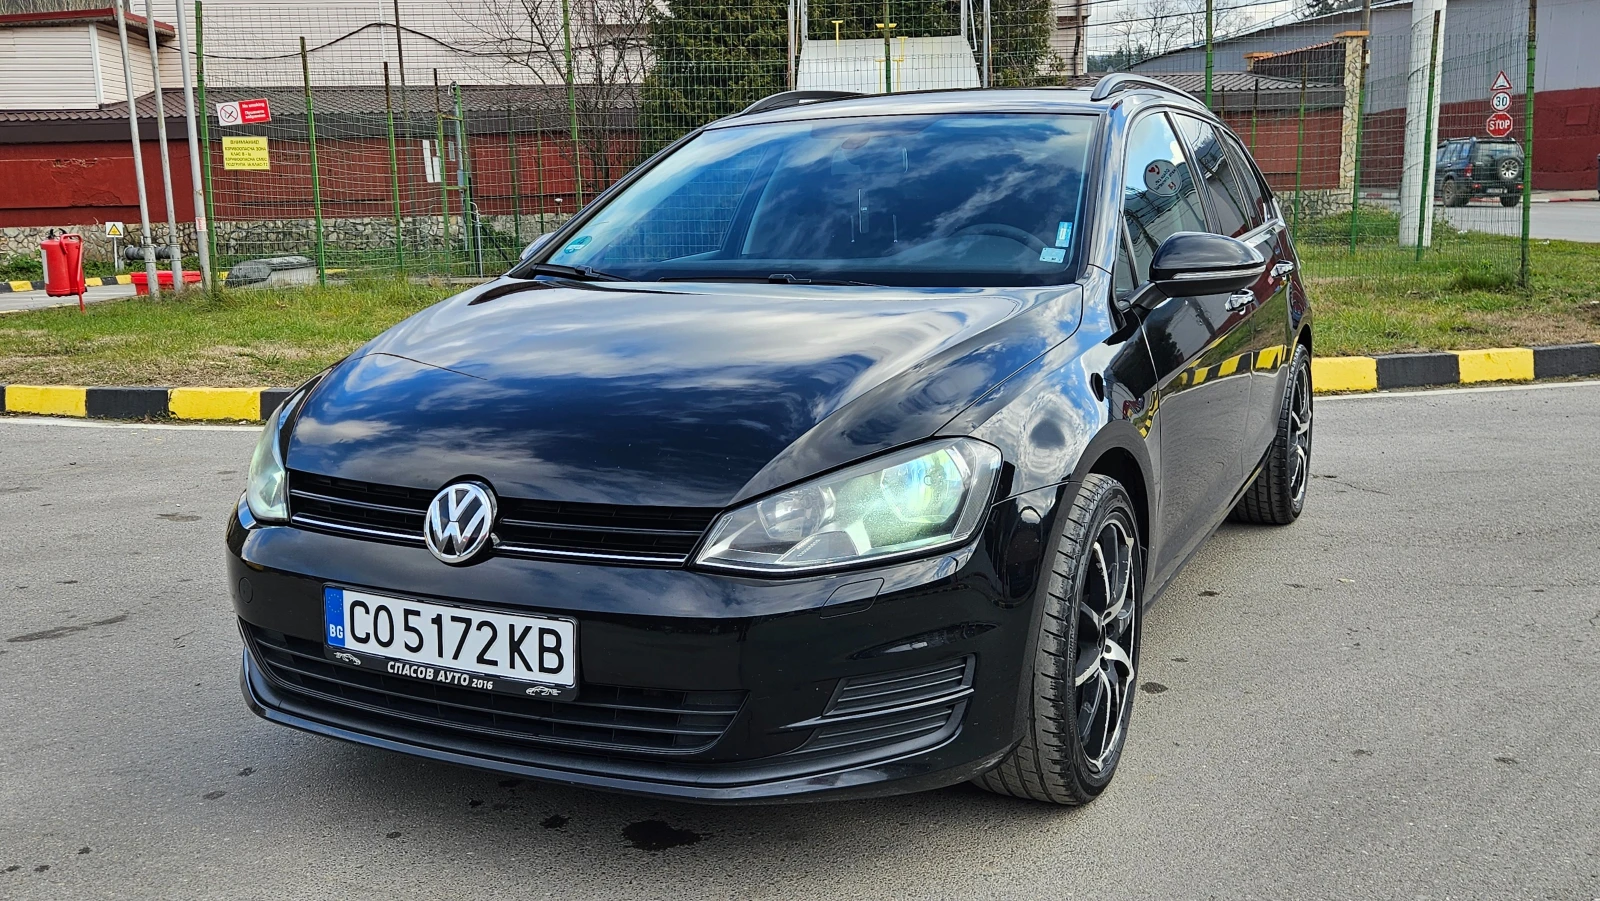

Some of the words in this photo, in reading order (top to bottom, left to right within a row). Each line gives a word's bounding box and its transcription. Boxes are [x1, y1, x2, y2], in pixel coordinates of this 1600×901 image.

[1495, 96, 1508, 107] 30
[1489, 119, 1510, 130] STOP
[329, 623, 344, 639] BG
[387, 661, 435, 680] СПАСОВ
[436, 670, 470, 687] АУТО
[471, 678, 494, 690] 2016
